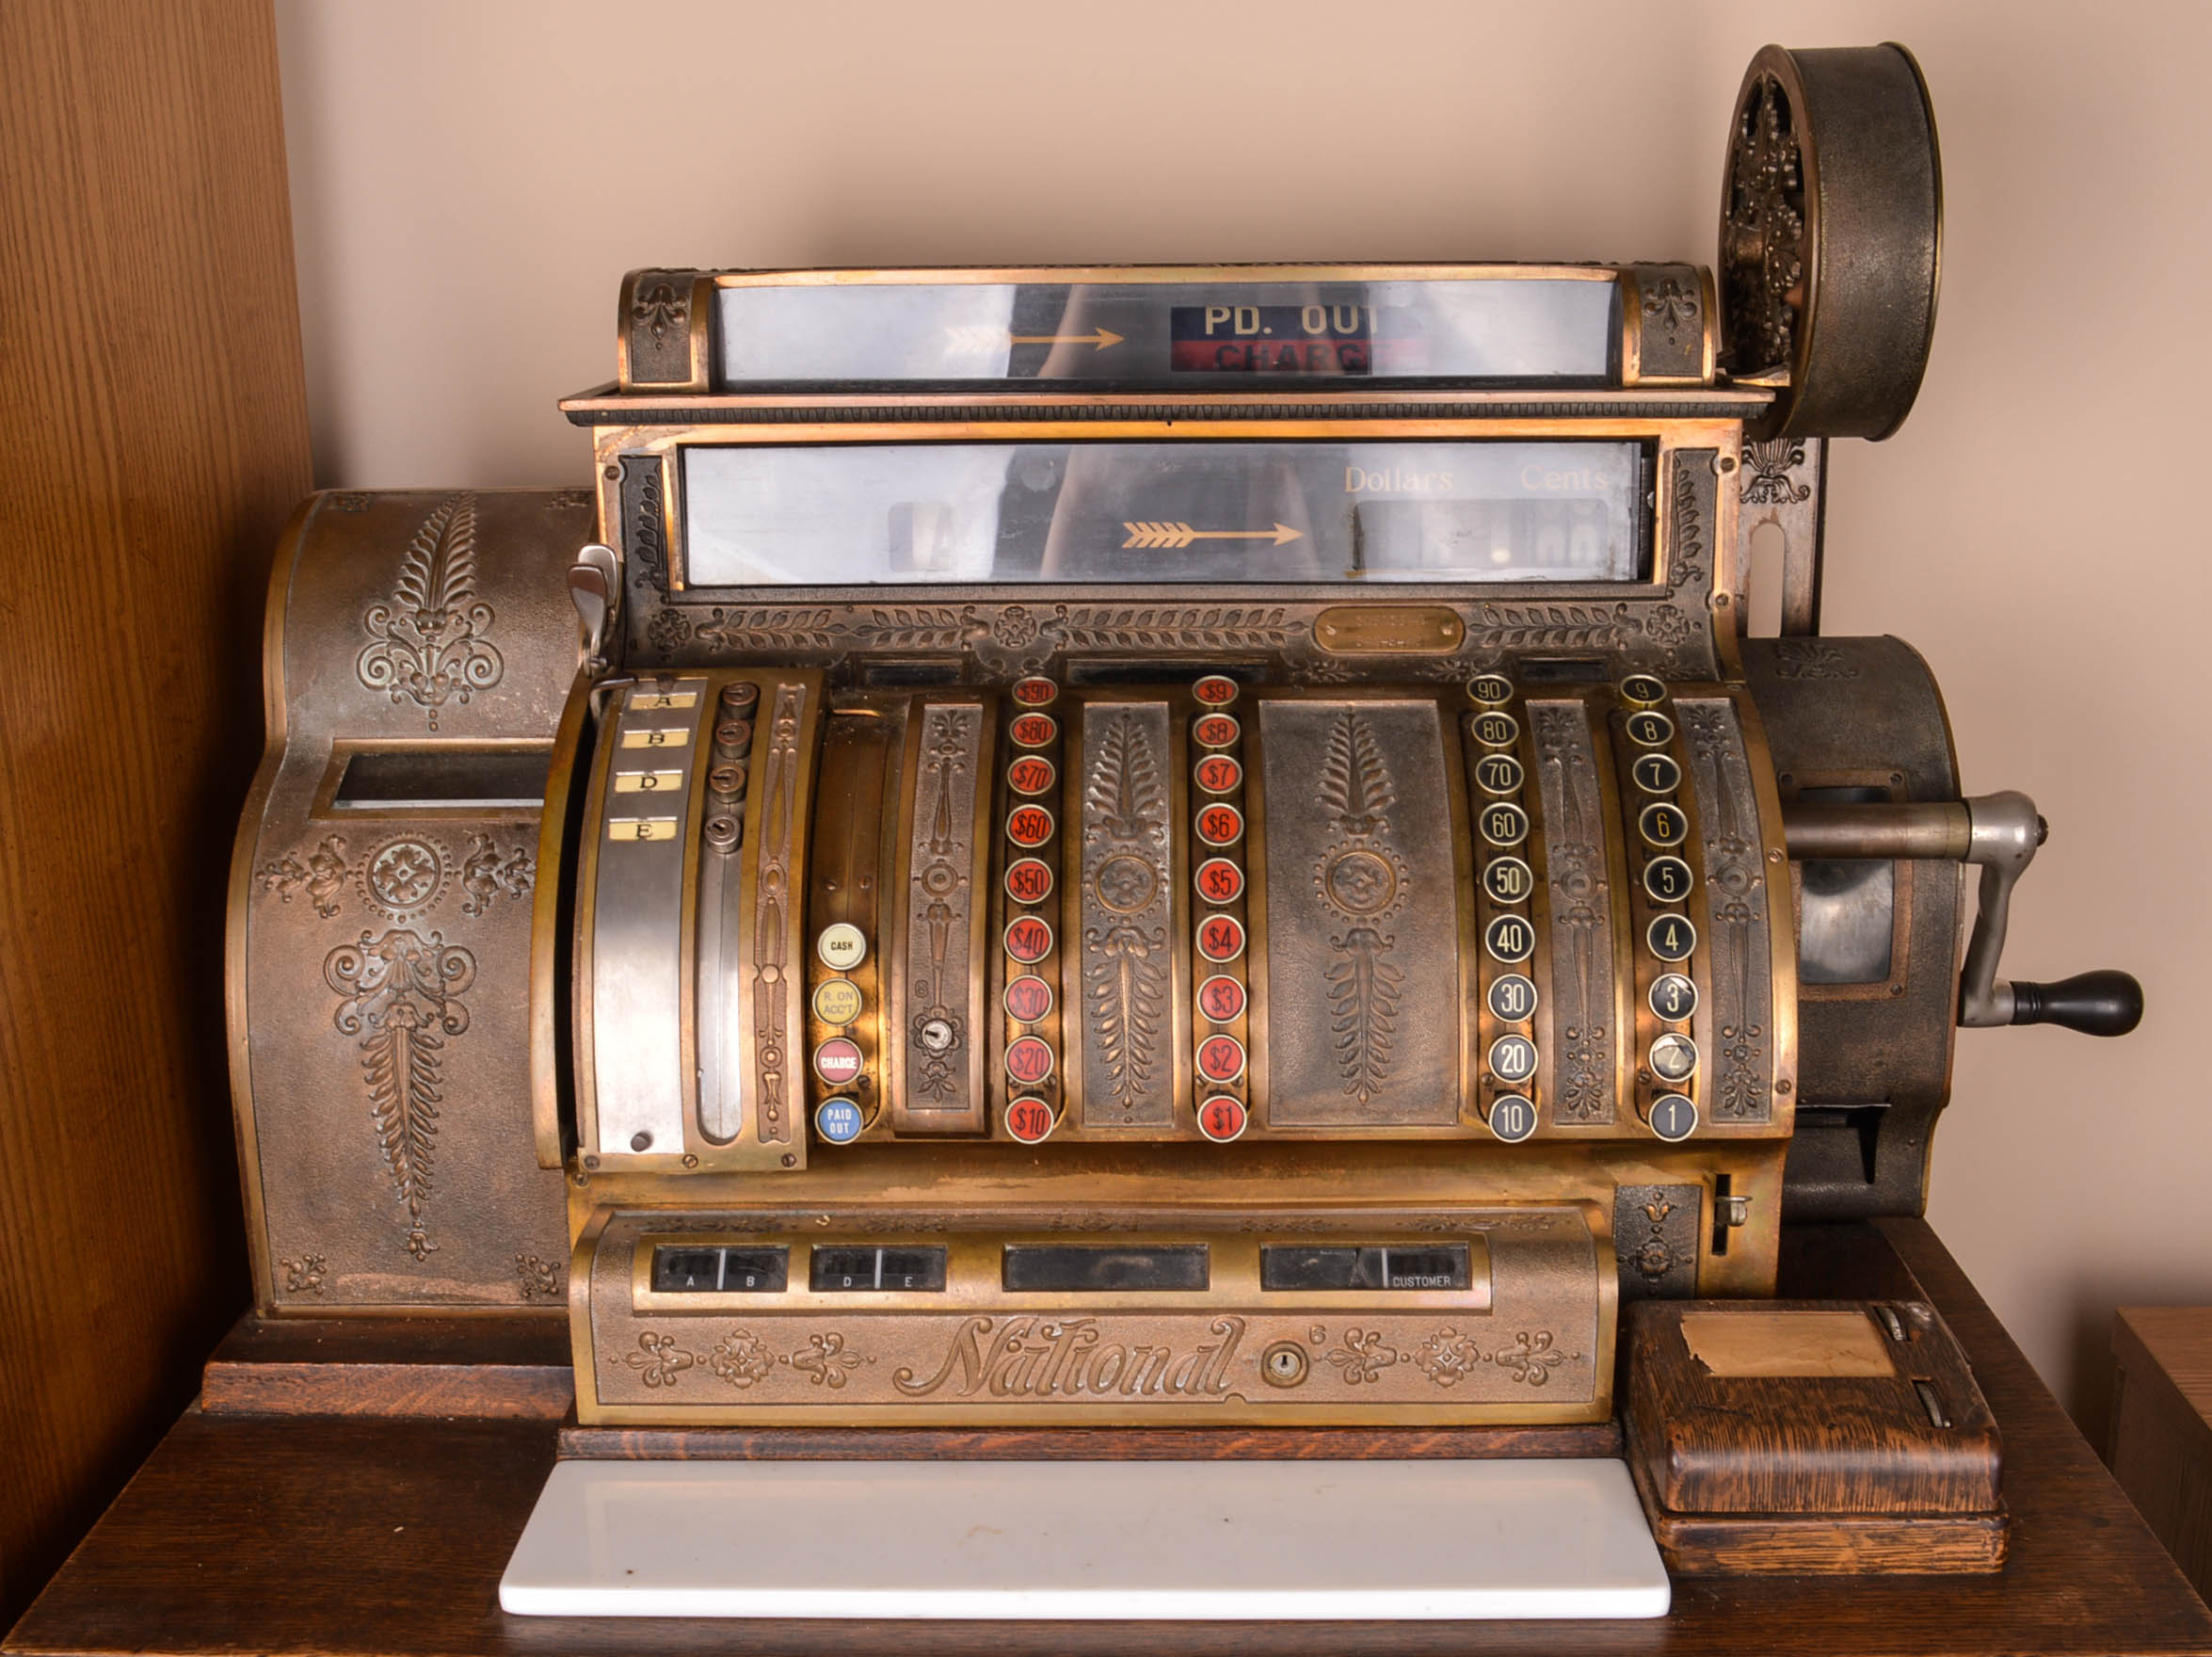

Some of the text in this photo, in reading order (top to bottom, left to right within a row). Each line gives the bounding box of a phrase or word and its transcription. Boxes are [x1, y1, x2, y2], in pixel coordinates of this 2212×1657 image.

[1205, 306, 1379, 335] PD. OUT
[1344, 466, 1609, 493] Dollars Cents
[654, 697, 671, 707] A
[1018, 683, 1050, 701] $90
[1205, 684, 1227, 700] $9
[1478, 682, 1500, 700] 90
[1635, 682, 1649, 700] 9
[648, 733, 665, 745] B
[1019, 720, 1048, 740] $80
[1206, 723, 1228, 742] $8
[1483, 720, 1506, 741] 80
[1643, 720, 1658, 741] 8
[640, 777, 657, 789] D
[1015, 764, 1049, 789] $70
[1208, 764, 1230, 785] $7
[1486, 763, 1512, 786] 70
[1649, 763, 1660, 786] 7
[636, 824, 653, 837] E
[1015, 812, 1048, 840] $60
[1208, 812, 1229, 838] $6
[1492, 812, 1515, 838] 60
[1657, 812, 1670, 837] 6
[1014, 868, 1045, 895] $50
[1209, 869, 1232, 896] $5
[1496, 866, 1520, 894] 50
[1661, 867, 1675, 893] 5
[830, 941, 854, 951] CASH
[1012, 926, 1044, 957] $40
[1209, 925, 1233, 952] $4
[1497, 924, 1522, 953] 40
[1665, 924, 1678, 952] 4
[824, 992, 854, 1002] R. ON
[1013, 986, 1045, 1015] $30
[1211, 986, 1234, 1014] $3
[1501, 983, 1525, 1013] 30
[1666, 983, 1679, 1013] 3
[820, 1056, 858, 1070] CHARGE
[1014, 1046, 1046, 1076] $20
[1210, 1044, 1233, 1072] $2
[1501, 1044, 1526, 1073] 20
[1668, 1044, 1680, 1070] 2
[827, 1109, 852, 1120] PAID
[1015, 1107, 1047, 1135] $10
[1212, 1107, 1232, 1132] $1
[1501, 1105, 1523, 1133] 10
[1668, 1103, 1676, 1132] 1
[829, 1122, 850, 1134] OUT
[686, 1277, 695, 1287] A
[746, 1277, 755, 1287] B
[843, 1277, 852, 1287] D
[905, 1277, 912, 1287] E
[1393, 1276, 1451, 1287] CUSTOMER
[892, 1317, 1246, 1397] National
